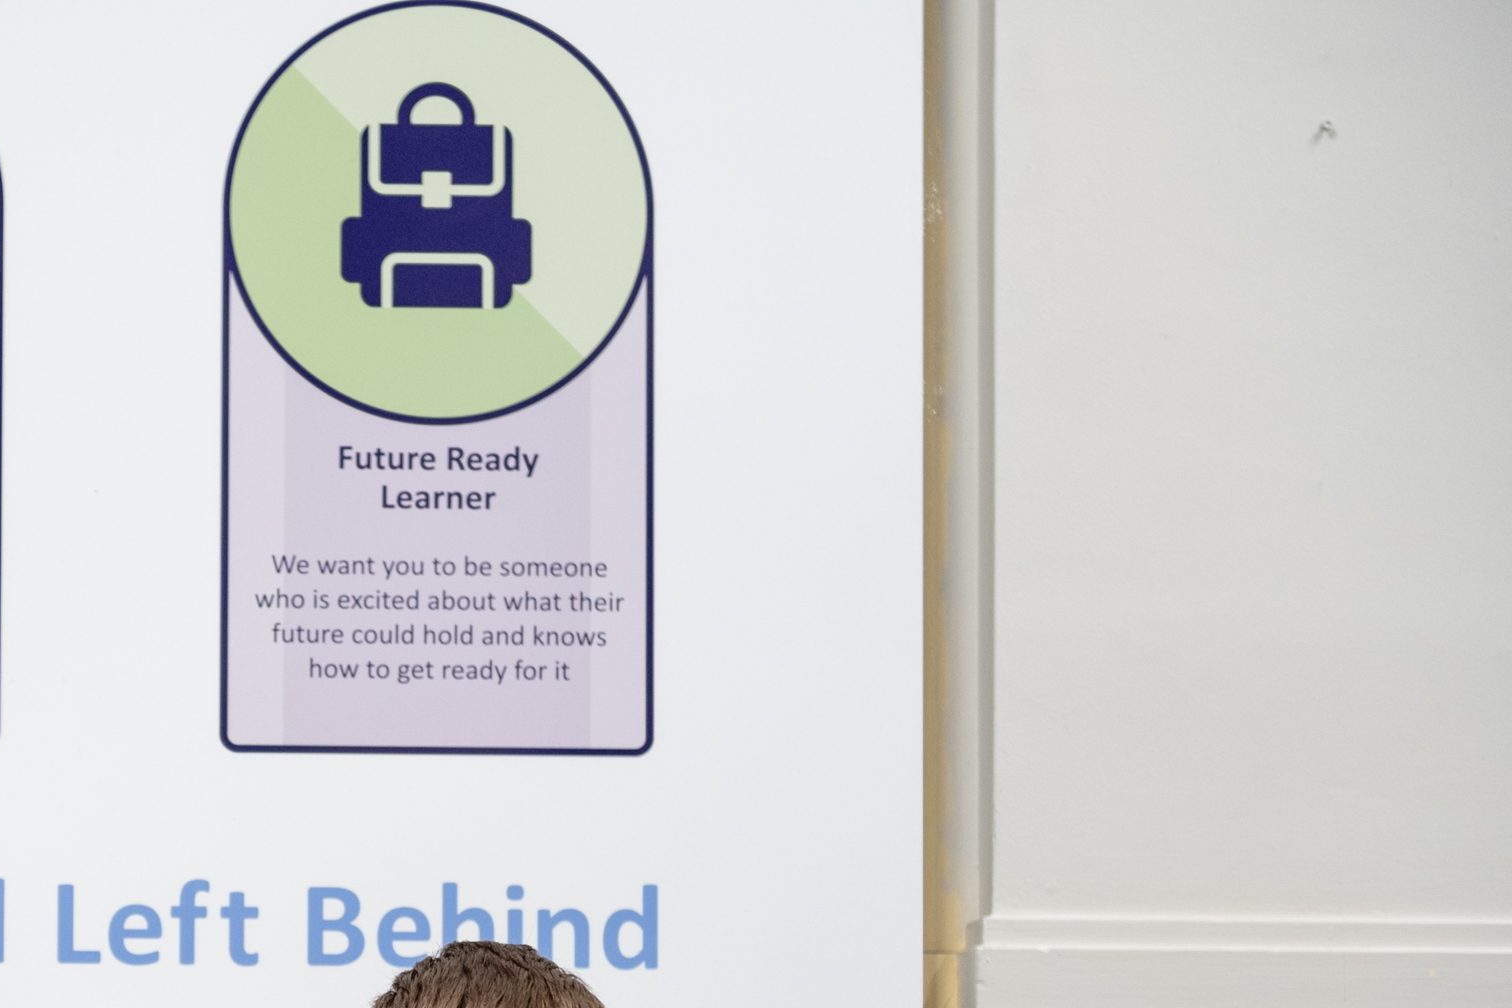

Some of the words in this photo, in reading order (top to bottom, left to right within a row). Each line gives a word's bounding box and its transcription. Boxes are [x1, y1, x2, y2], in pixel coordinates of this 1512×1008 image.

[337, 444, 437, 472] Future
[446, 444, 540, 479] Ready
[380, 484, 497, 511] Learner
[270, 554, 310, 576] We
[316, 556, 376, 576] want
[381, 559, 425, 581] you
[431, 557, 457, 577] to
[463, 554, 493, 577] be
[499, 560, 608, 579] someone
[254, 587, 306, 610] who
[312, 588, 330, 610] is
[336, 588, 420, 611] excited
[427, 589, 497, 612] about
[502, 589, 562, 613] what
[568, 590, 626, 613] their
[271, 621, 345, 645] future
[351, 623, 415, 646] could
[422, 623, 474, 646] hold
[481, 624, 525, 647] and
[532, 624, 608, 648] knows
[309, 656, 360, 680] how
[365, 660, 391, 680] to
[396, 660, 435, 685] get
[441, 658, 508, 686] ready
[513, 658, 548, 681] for
[554, 660, 571, 682] it
[57, 879, 259, 967] Left
[307, 881, 659, 970] Behind
